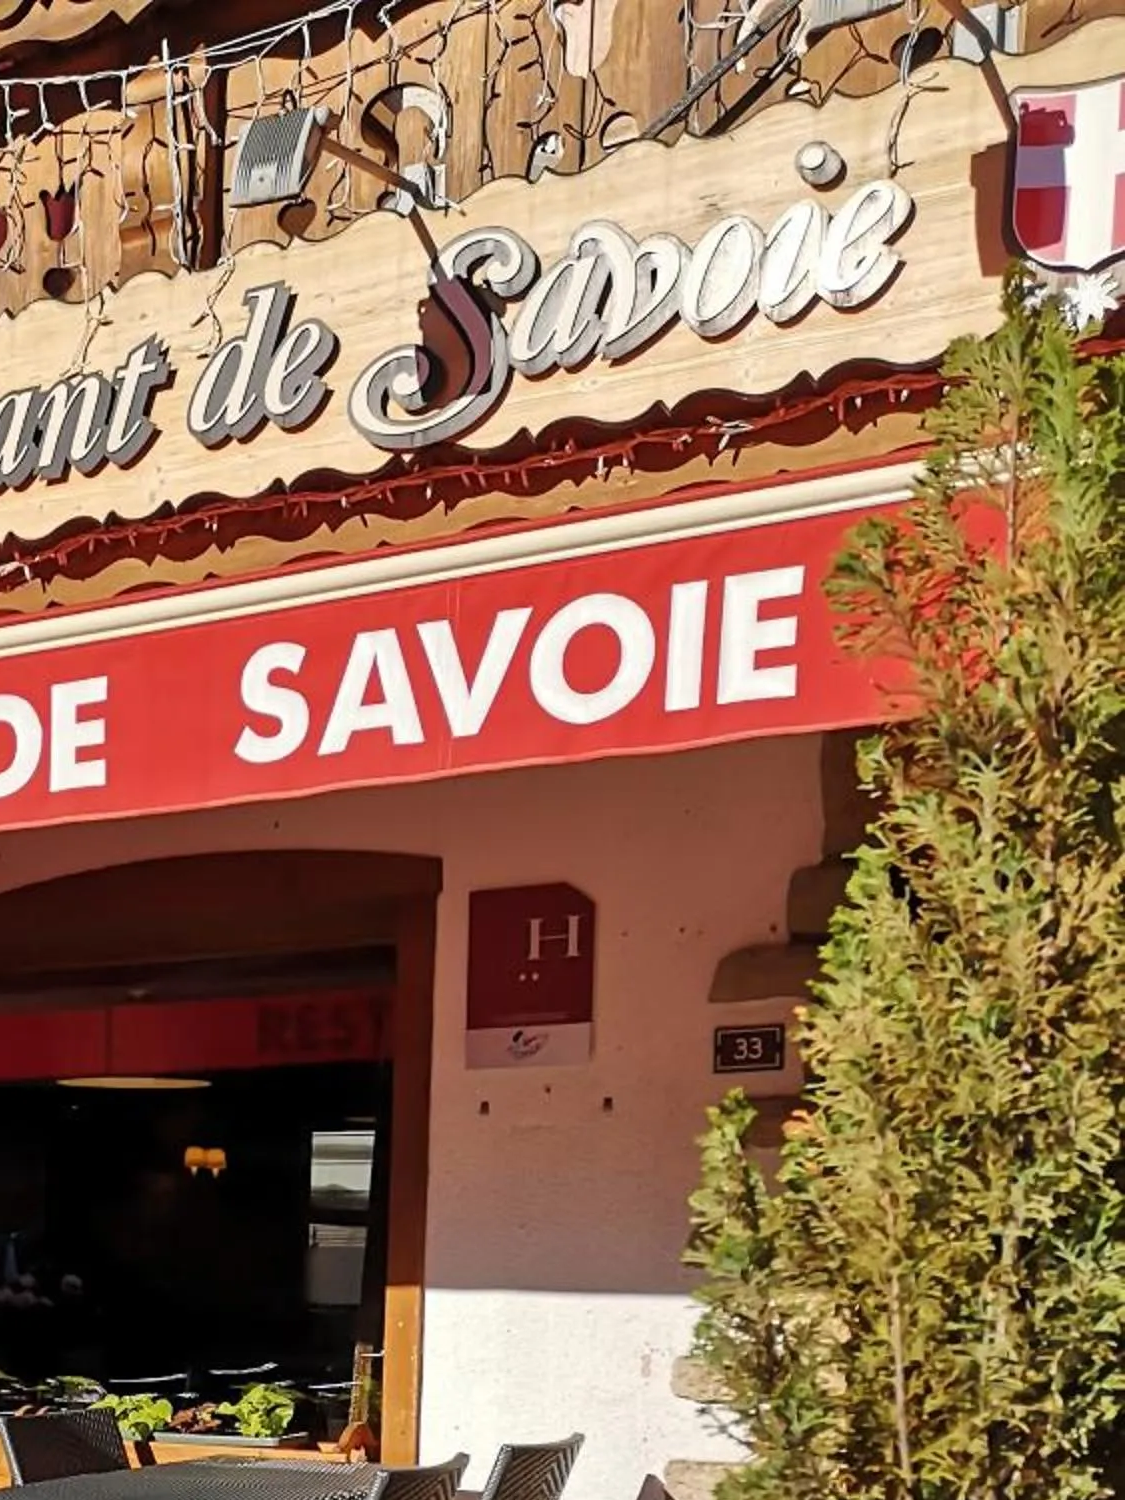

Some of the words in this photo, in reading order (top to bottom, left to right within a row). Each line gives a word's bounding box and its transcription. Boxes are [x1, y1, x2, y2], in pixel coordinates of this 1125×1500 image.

[187, 281, 338, 446] de
[348, 141, 914, 449] Savoie
[234, 565, 805, 764] SAVOIE
[528, 914, 583, 960] H
[733, 1037, 763, 1060] 33
